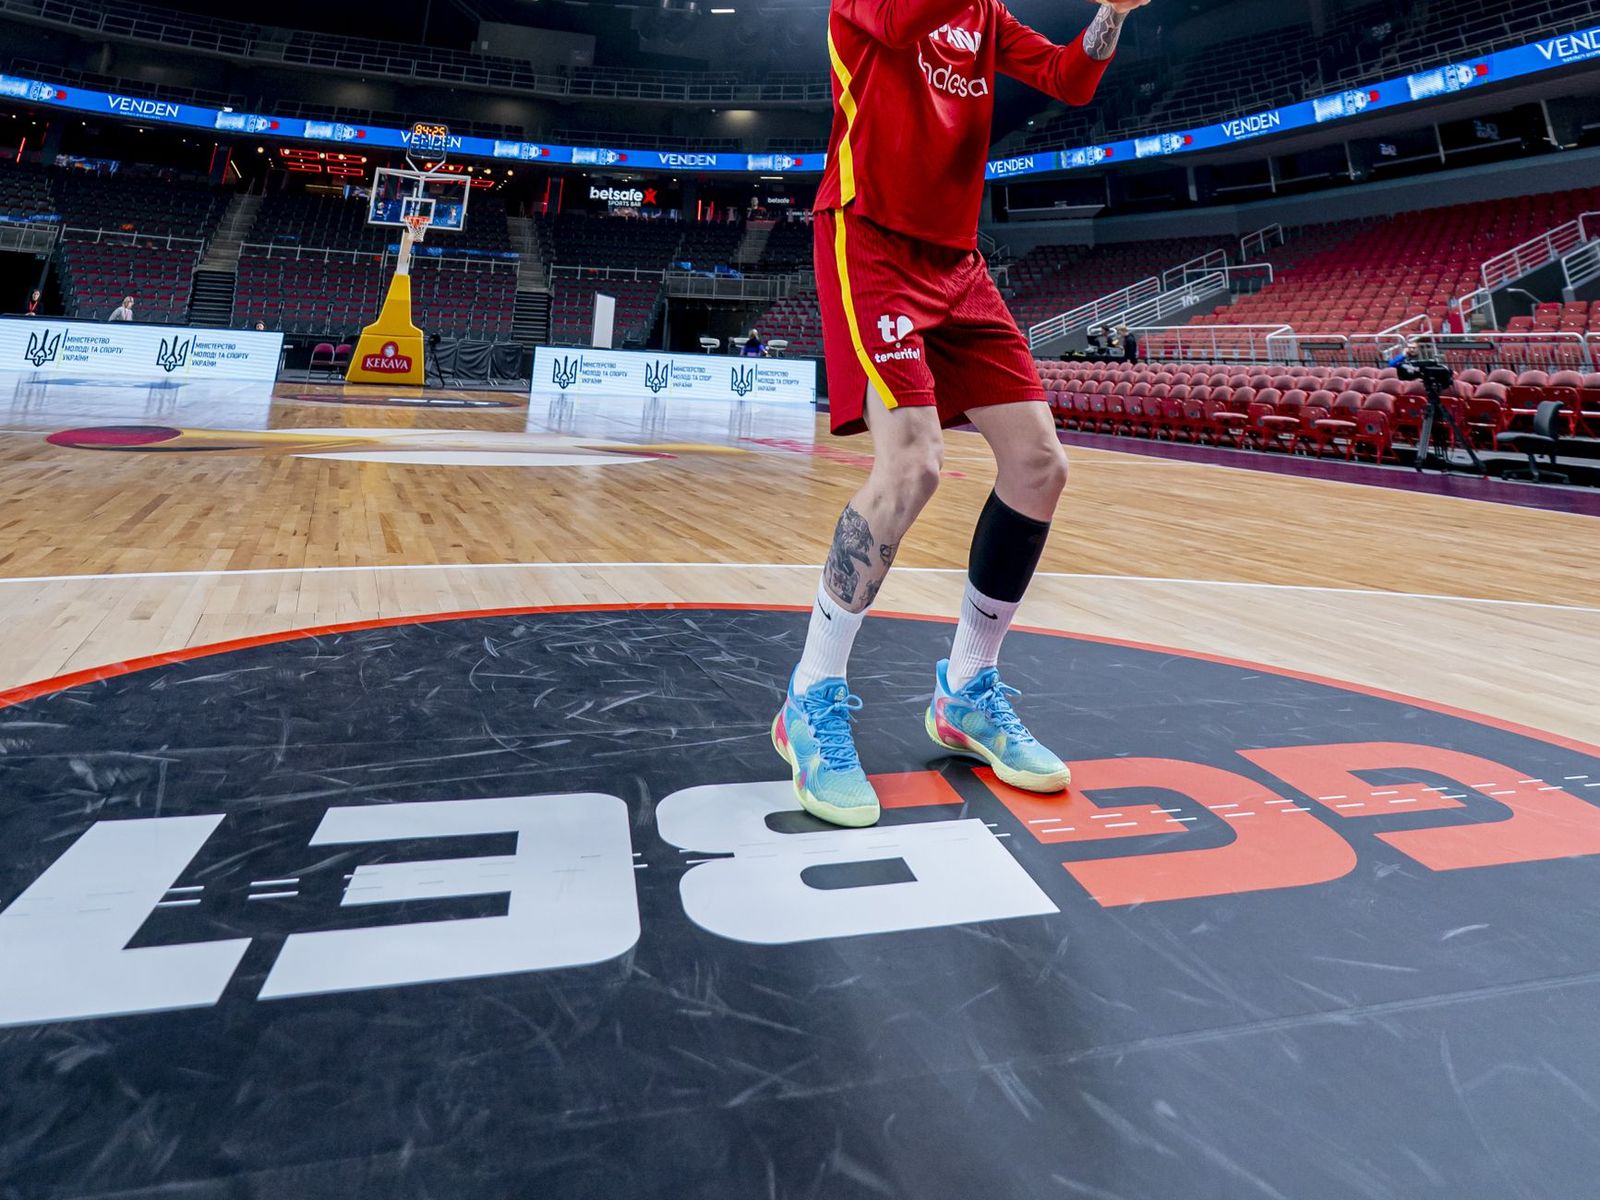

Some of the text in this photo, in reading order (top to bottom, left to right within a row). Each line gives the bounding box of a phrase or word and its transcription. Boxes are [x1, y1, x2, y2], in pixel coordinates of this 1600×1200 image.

[108, 95, 180, 118] VENDEN
[415, 124, 446, 138] 84:25
[1220, 111, 1281, 138] VENDEN
[400, 130, 462, 148] VENDEN
[658, 152, 717, 166] VENDEN
[987, 156, 1035, 174] VENDEN
[589, 186, 644, 201] betsafe
[100, 347, 123, 355] СПОРТУ
[0, 740, 1600, 1025] GGBET
